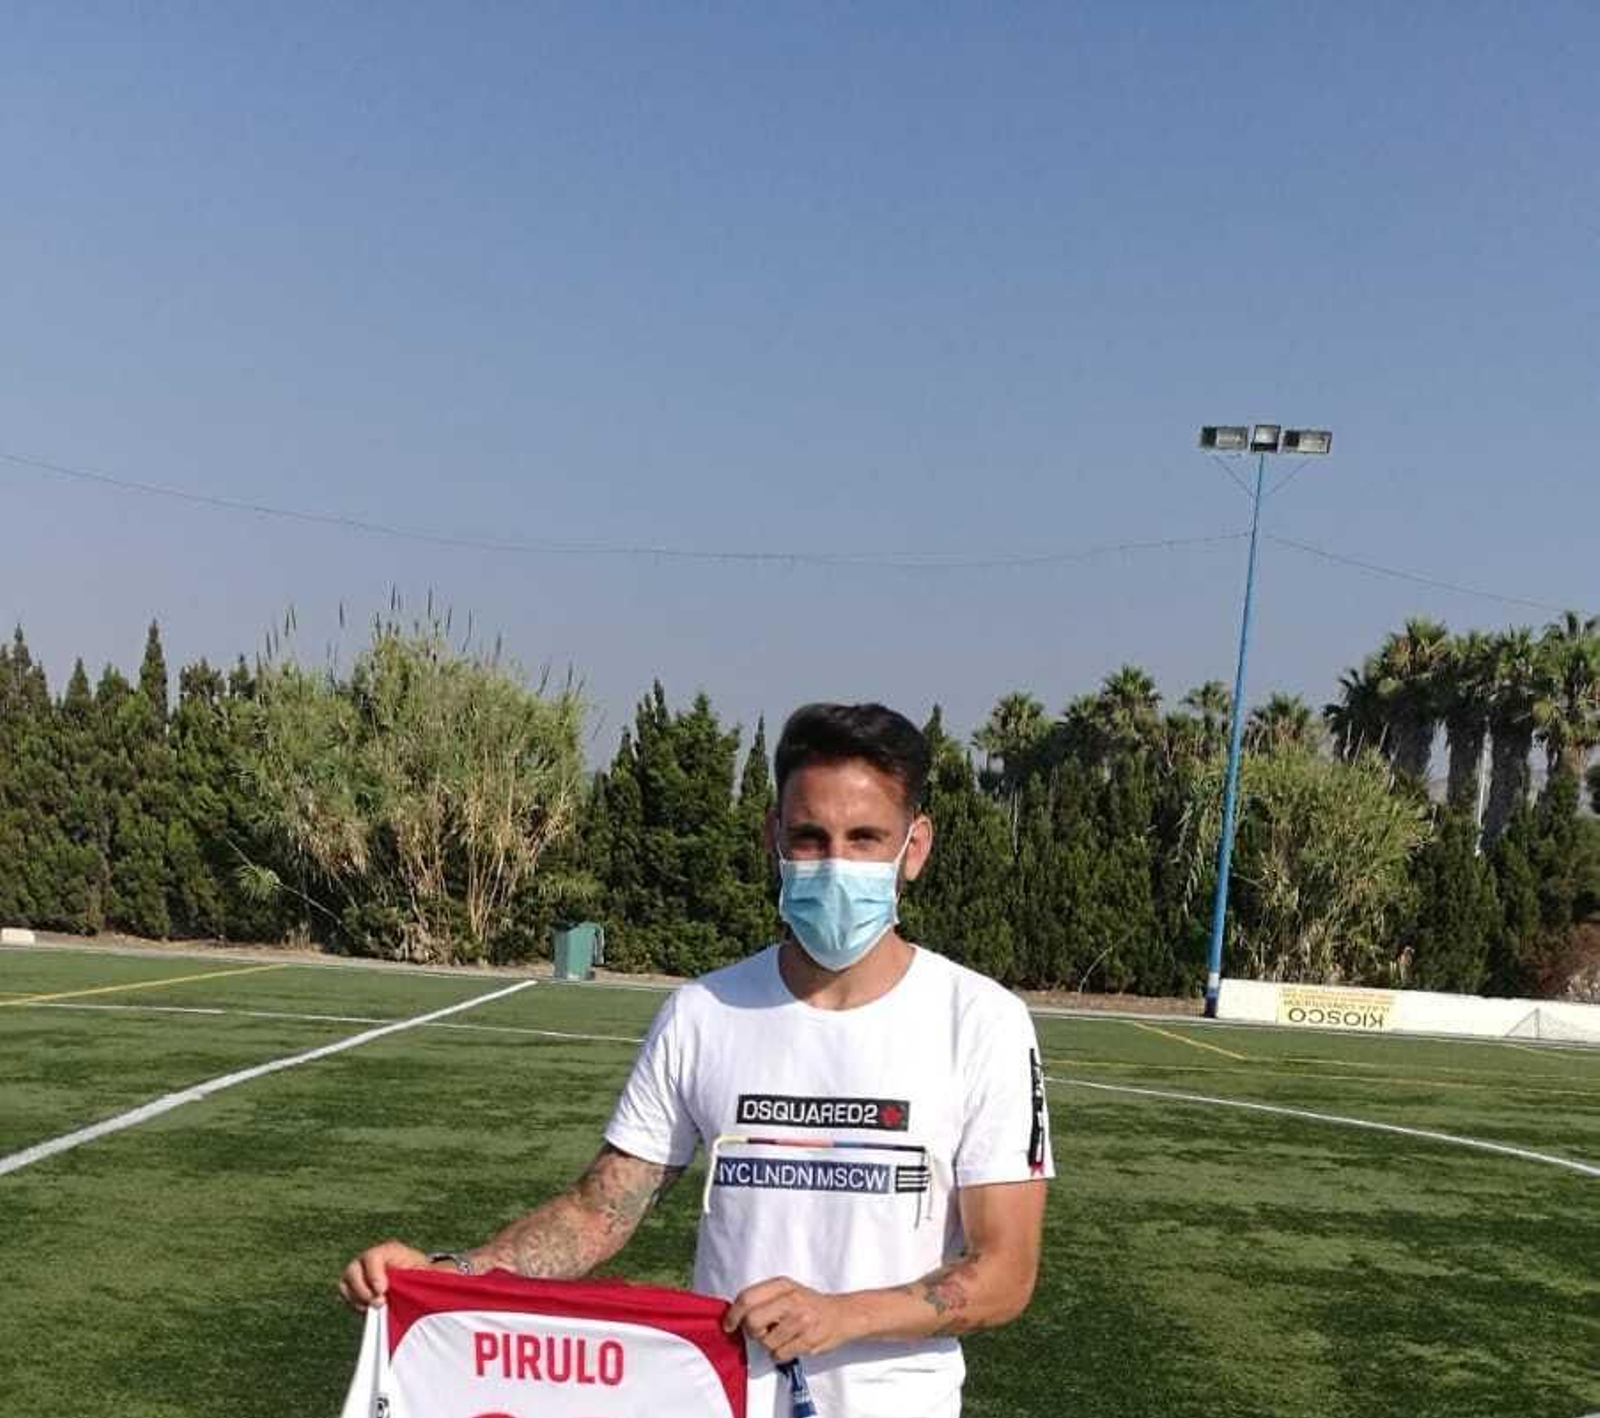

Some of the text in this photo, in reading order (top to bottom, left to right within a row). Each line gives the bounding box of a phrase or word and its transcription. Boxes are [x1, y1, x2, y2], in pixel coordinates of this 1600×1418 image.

[1288, 1007, 1384, 1029] KIOSCO
[742, 1099, 879, 1125] DSQUARED2
[473, 1331, 625, 1386] PIRULO
